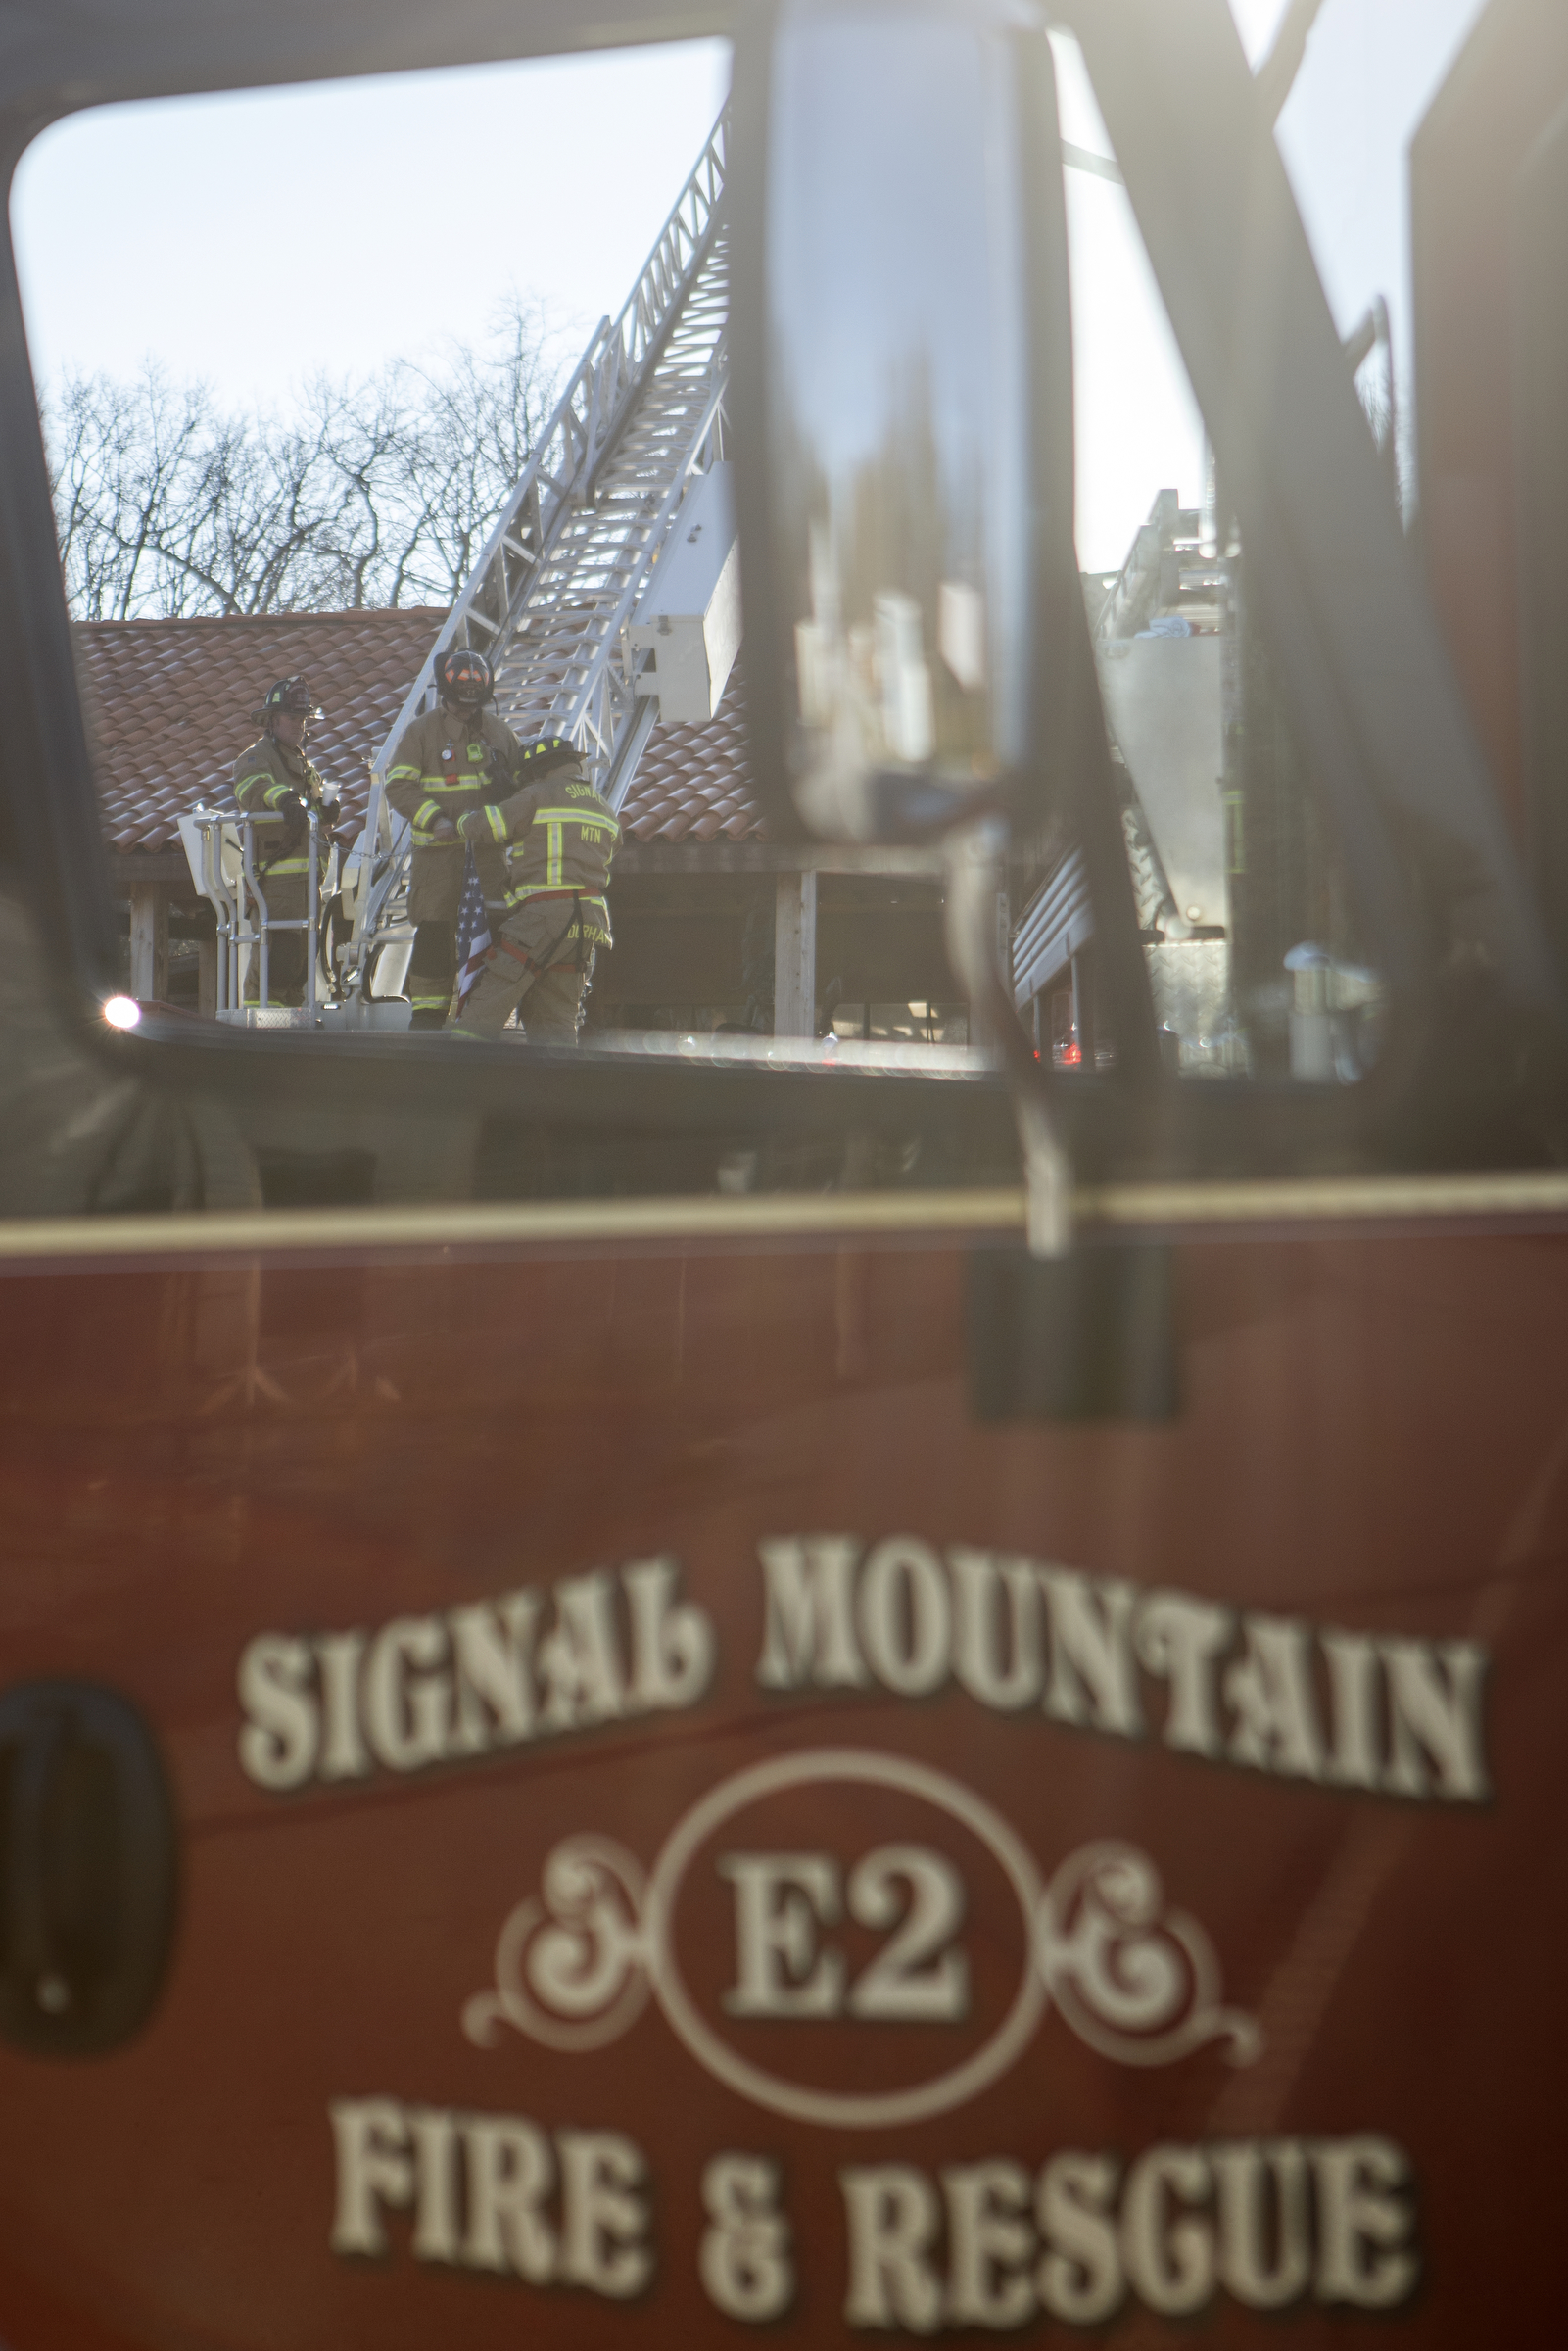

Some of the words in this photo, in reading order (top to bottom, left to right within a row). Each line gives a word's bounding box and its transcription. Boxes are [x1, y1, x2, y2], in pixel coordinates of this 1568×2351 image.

[565, 784, 605, 806] SIGNAL
[581, 825, 600, 843] MTN
[238, 1555, 713, 1789] SIGNAL
[757, 1532, 1485, 1800] MOUNTAIN
[720, 1844, 968, 2020] E2
[330, 2096, 653, 2298] FIRE
[698, 2153, 791, 2320] &
[840, 2137, 1416, 2331] RESCUE
